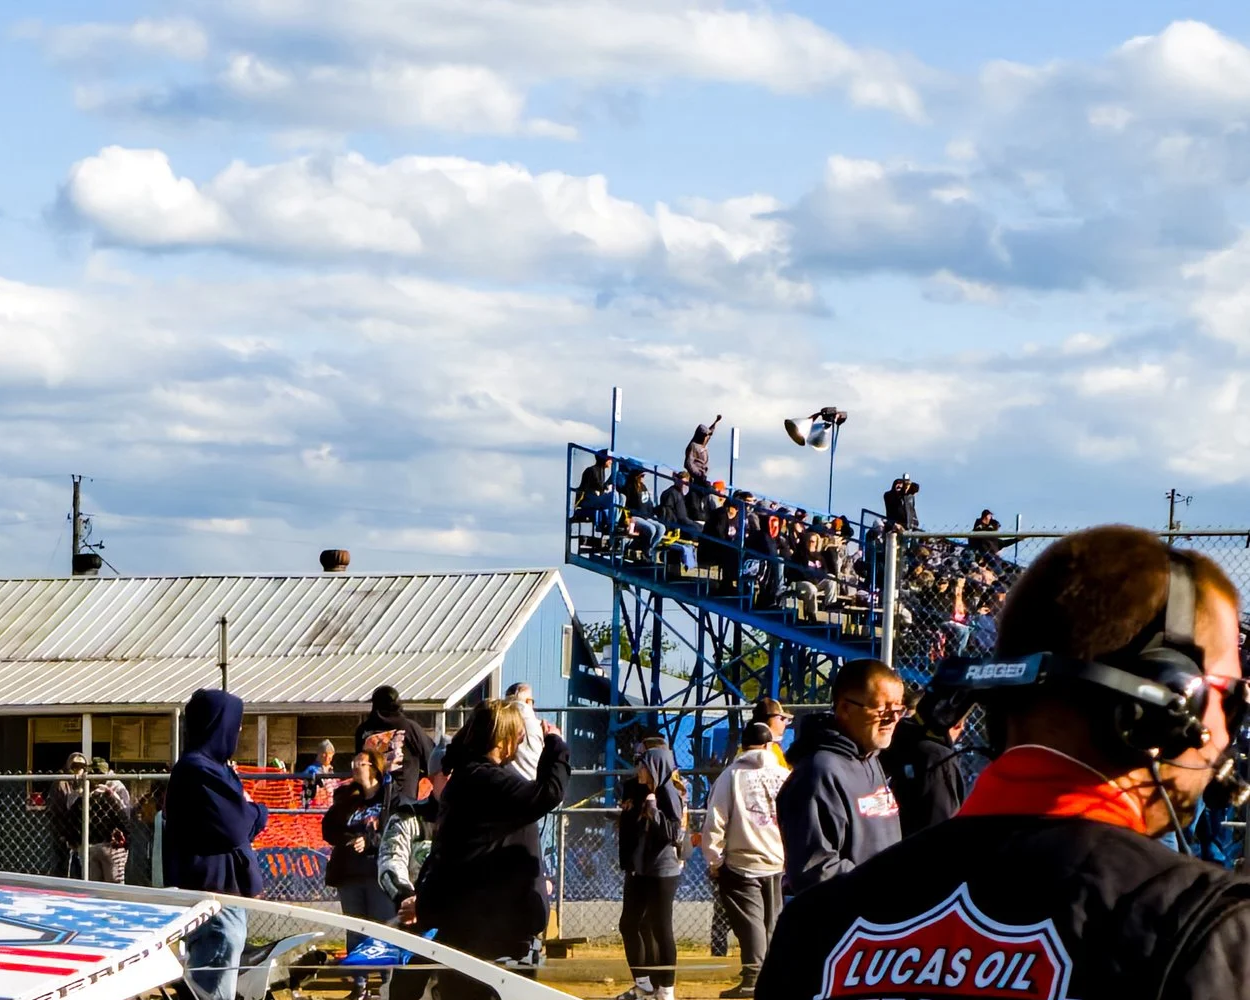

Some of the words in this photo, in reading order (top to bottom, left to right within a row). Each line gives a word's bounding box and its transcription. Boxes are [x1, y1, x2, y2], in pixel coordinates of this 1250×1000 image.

[965, 662, 1027, 680] RUGGED
[843, 947, 973, 988] LUCAS
[973, 950, 1037, 990] OIL
